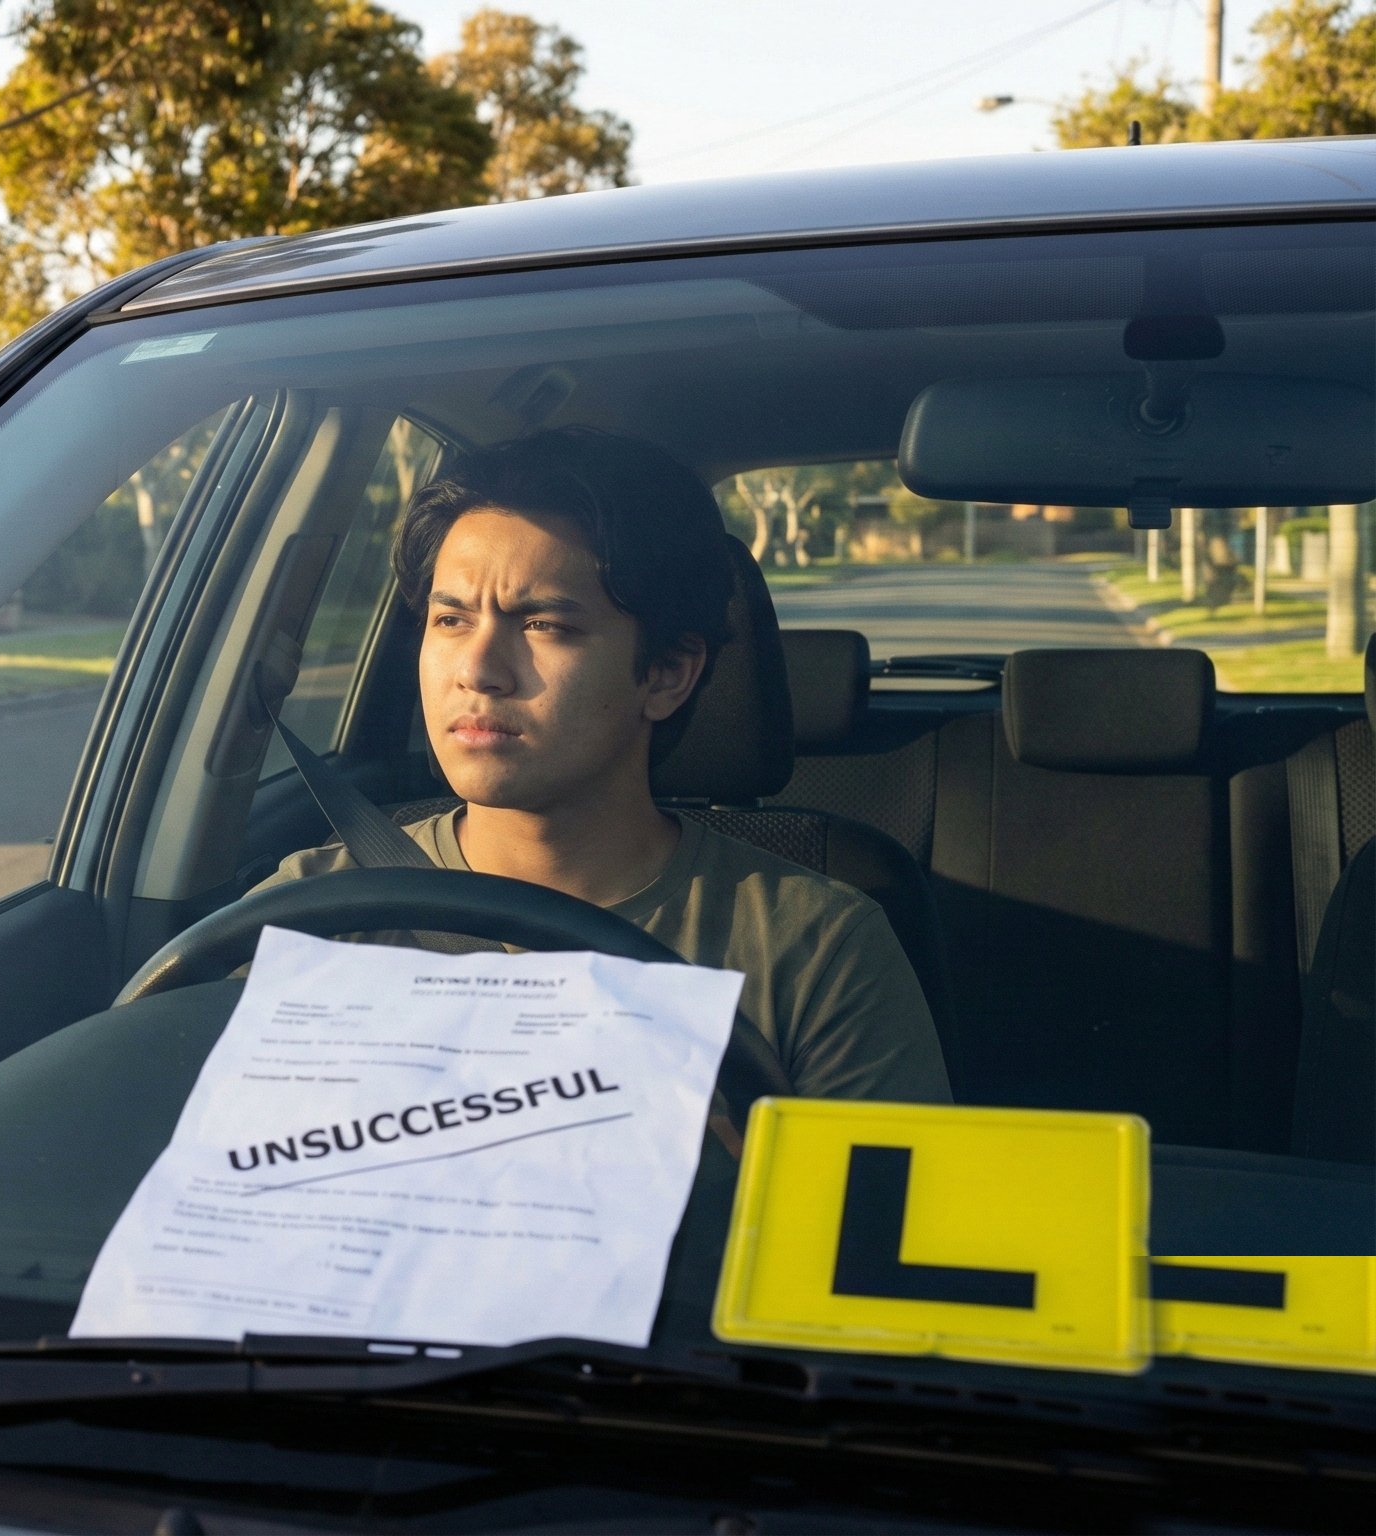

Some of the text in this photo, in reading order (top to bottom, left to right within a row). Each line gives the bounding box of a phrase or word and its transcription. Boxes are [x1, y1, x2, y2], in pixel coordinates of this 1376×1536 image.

[476, 977, 508, 986] TEST
[512, 978, 566, 987] RESULT
[228, 1068, 620, 1171] UNSUCCESSFUL
[831, 1144, 1036, 1311] L
